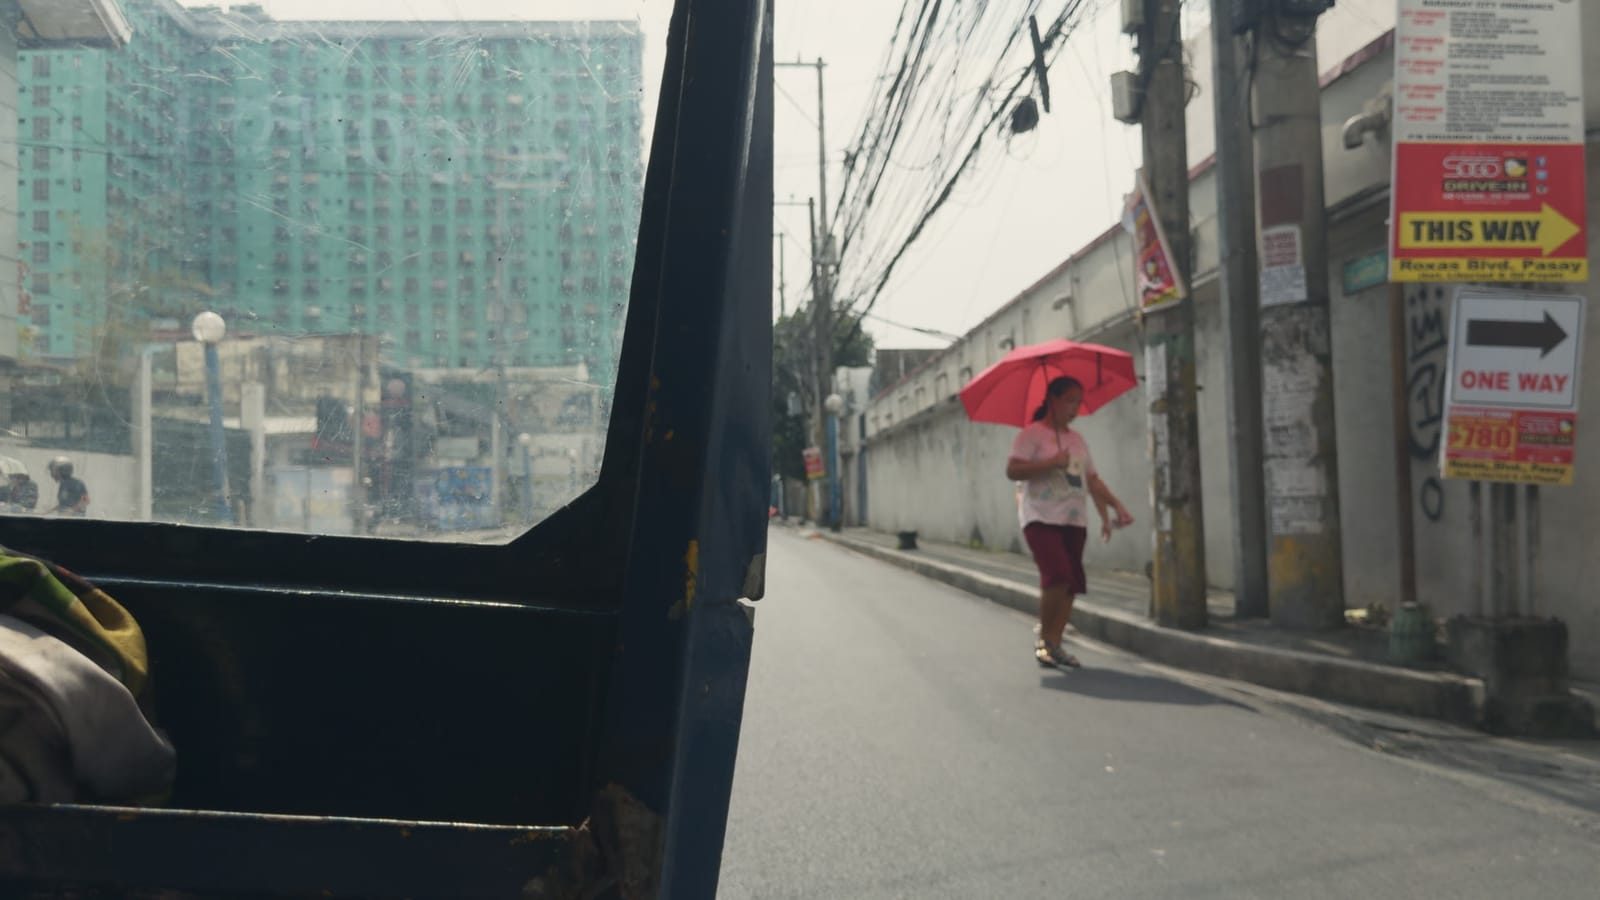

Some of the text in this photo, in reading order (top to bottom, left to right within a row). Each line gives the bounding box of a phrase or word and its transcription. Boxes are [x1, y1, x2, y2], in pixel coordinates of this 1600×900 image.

[1410, 219, 1540, 242] THIS WAY
[1399, 260, 1461, 272] Roxas
[1522, 259, 1582, 274] Pasay
[1460, 370, 1569, 394] ONE WAY
